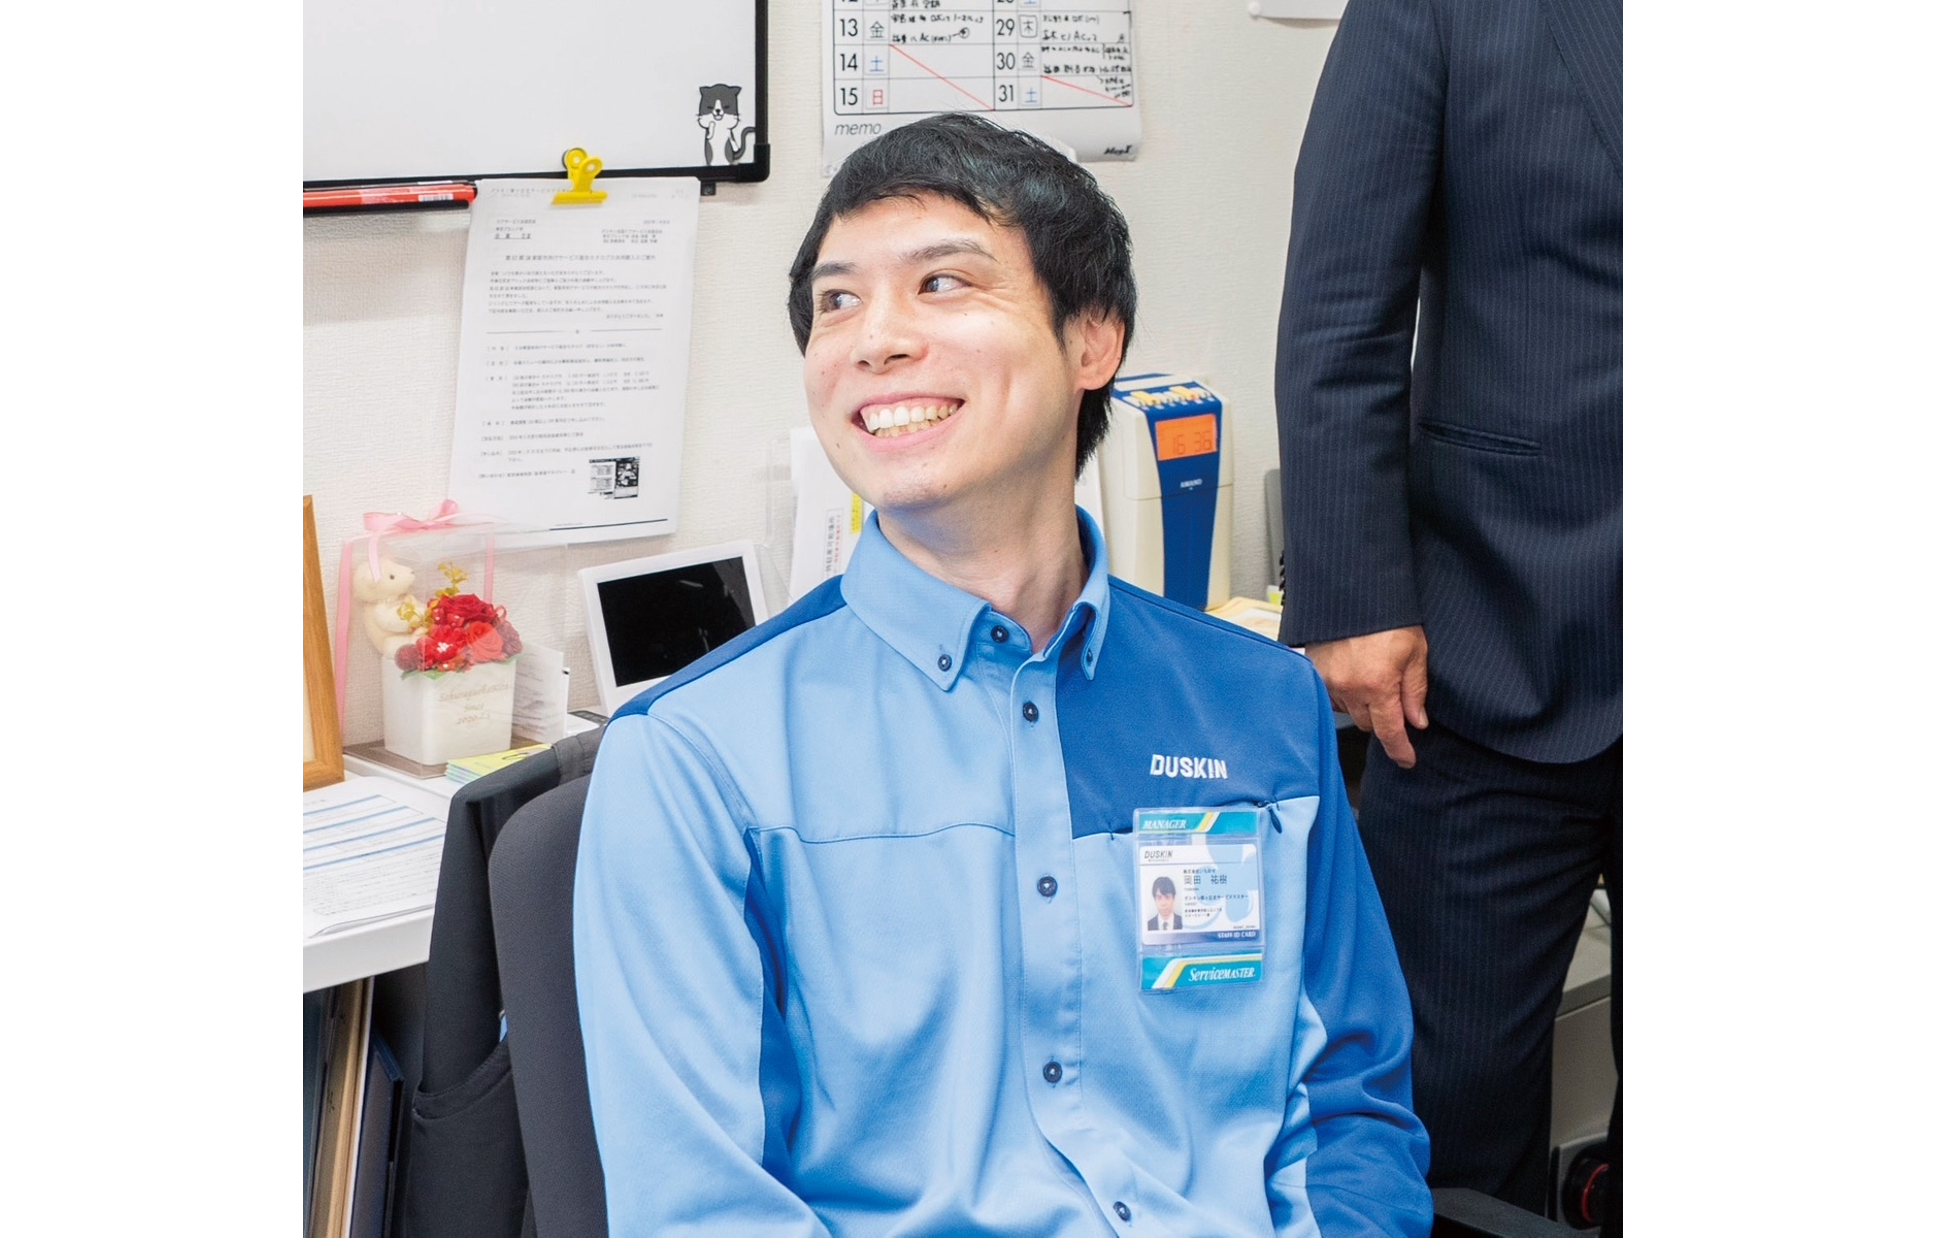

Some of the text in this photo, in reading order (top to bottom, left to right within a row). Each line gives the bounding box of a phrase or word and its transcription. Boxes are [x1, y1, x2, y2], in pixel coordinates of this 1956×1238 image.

[839, 18, 859, 37] 13
[869, 20, 885, 38] 金
[996, 18, 1016, 36] 29
[1022, 20, 1035, 34] 木
[839, 53, 883, 73] 14 土
[996, 52, 1035, 71] 30 金
[839, 87, 884, 106] 15 日
[998, 84, 1037, 103] 31 土
[834, 122, 882, 136] memo
[1151, 754, 1228, 779] DUSKIN
[1142, 819, 1188, 830] MANAGER
[1144, 849, 1173, 859] DUSKIN
